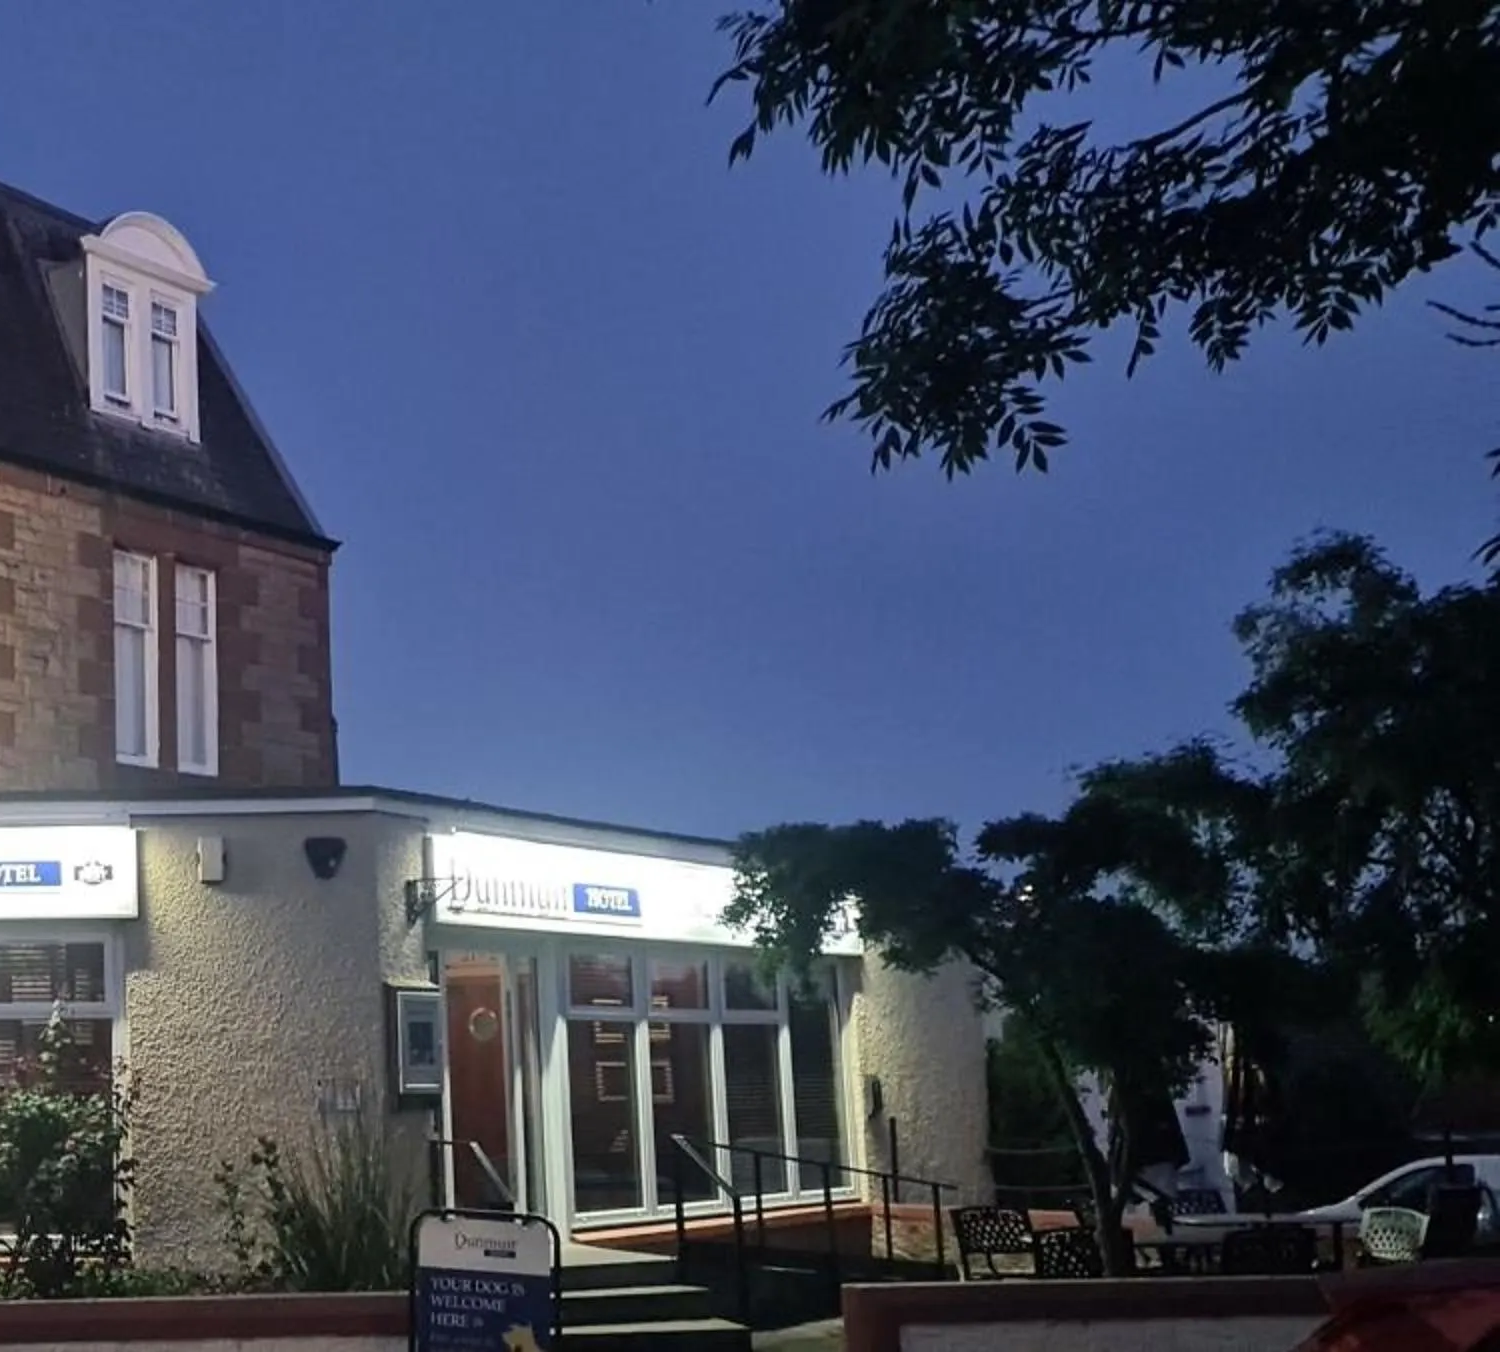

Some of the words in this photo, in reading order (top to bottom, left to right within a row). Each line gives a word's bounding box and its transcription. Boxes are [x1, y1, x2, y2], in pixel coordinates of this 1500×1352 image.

[430, 1277, 471, 1293] YOUR
[475, 1280, 510, 1296] DOG
[430, 1294, 506, 1313] WELCOME
[430, 1312, 470, 1328] HERE
